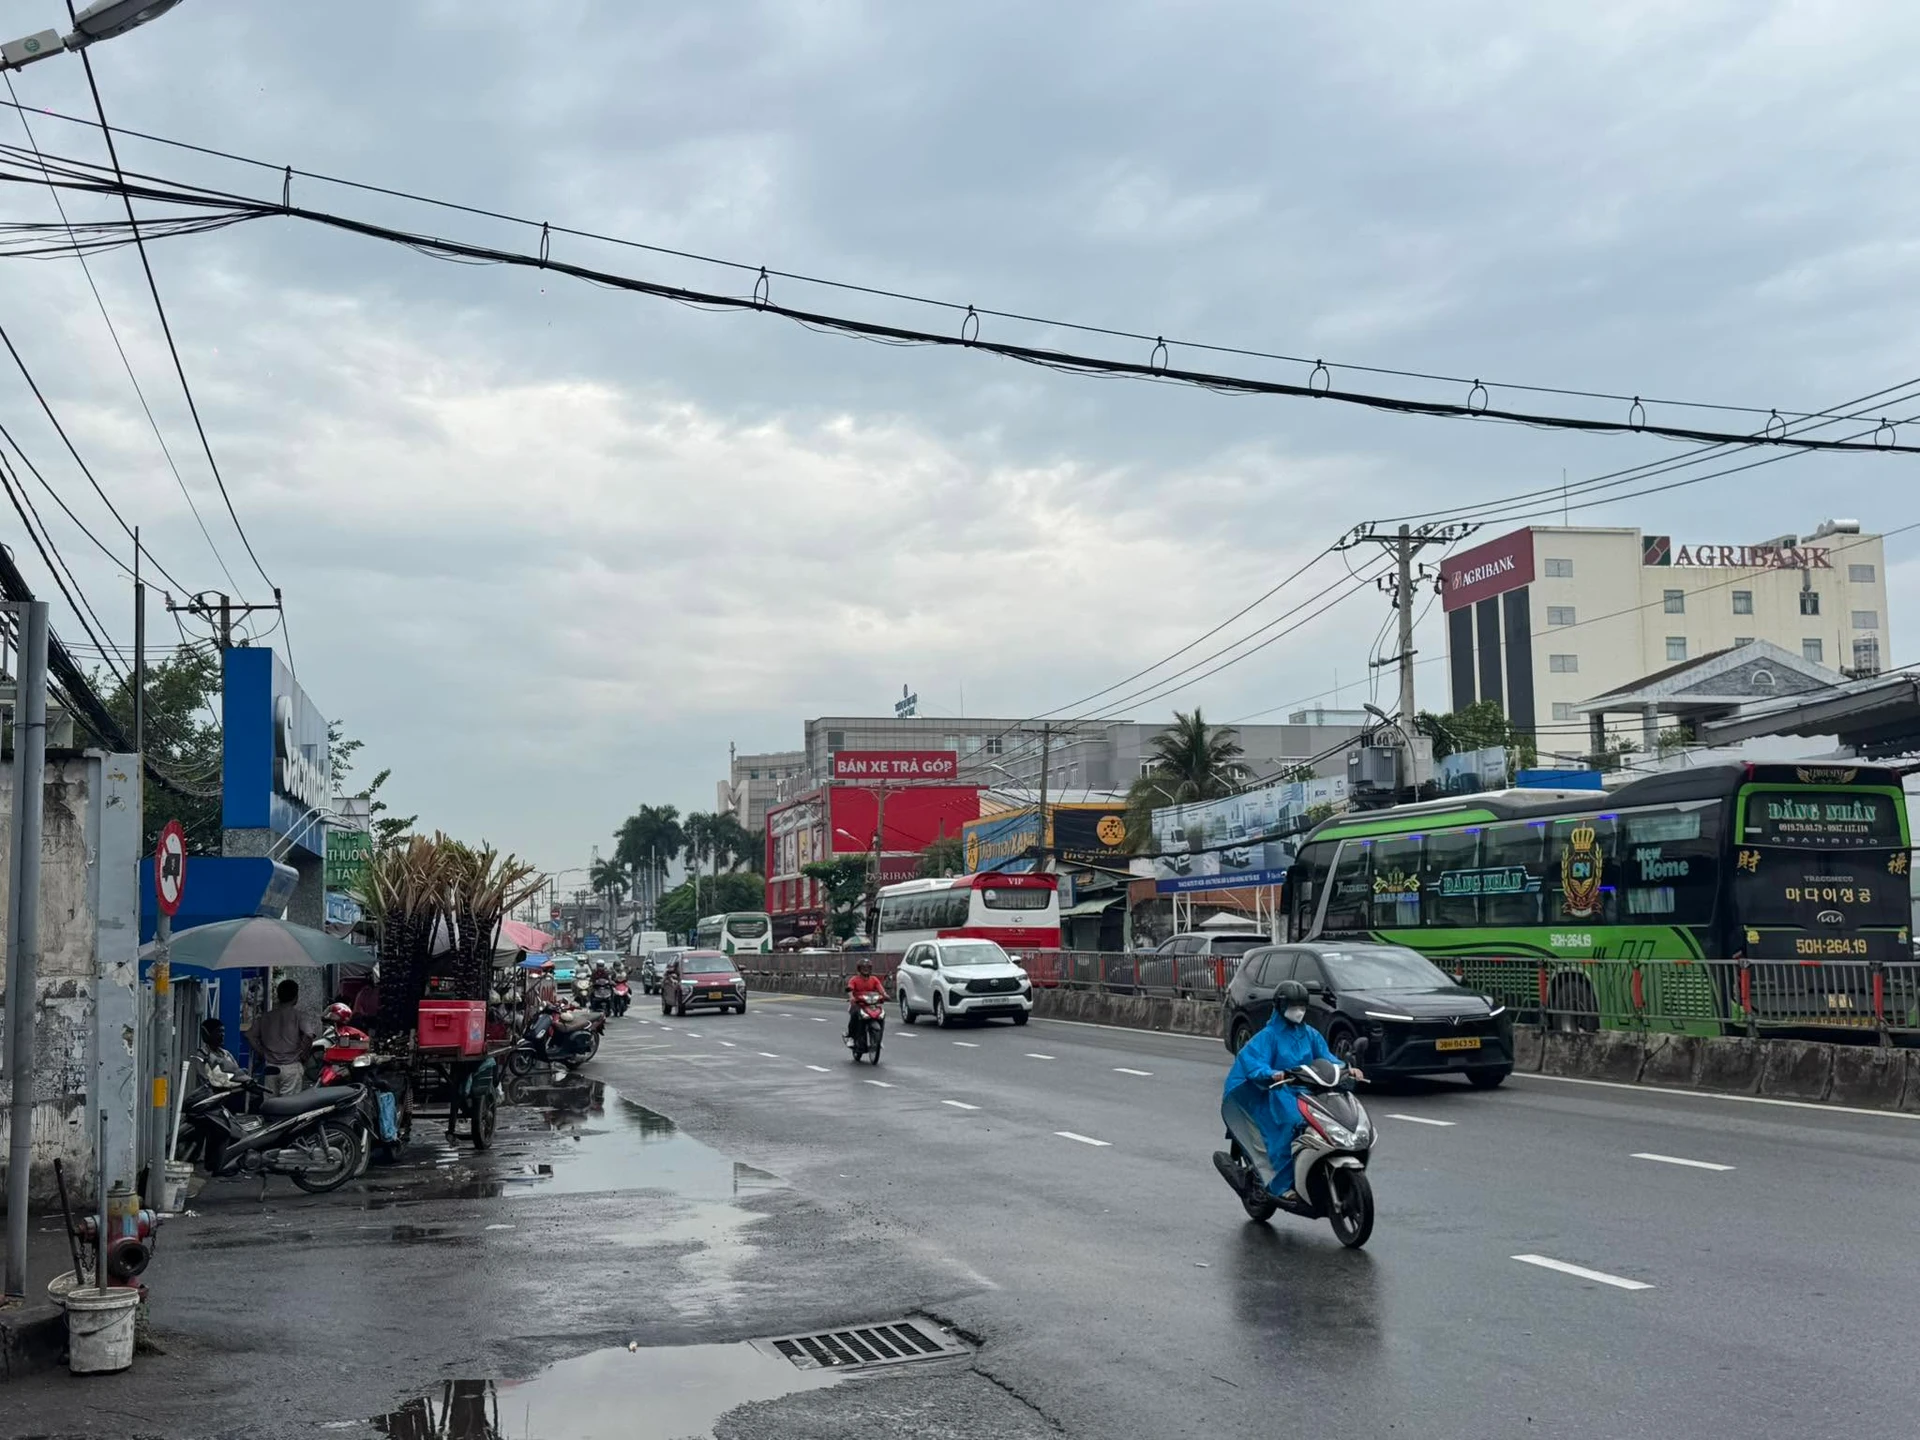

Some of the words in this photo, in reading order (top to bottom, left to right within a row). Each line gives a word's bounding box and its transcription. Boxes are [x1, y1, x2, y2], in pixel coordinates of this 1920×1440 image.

[1674, 544, 1834, 570] AGRIBANK
[1462, 554, 1515, 588] AGRIBANK
[837, 758, 867, 773] BÁN
[870, 760, 889, 773] XE
[891, 757, 920, 773] TRẢ
[922, 757, 953, 773] GÓP
[1768, 798, 1820, 820] ĐĂNG
[1825, 800, 1877, 822] NHÂN
[1635, 847, 1662, 862] New
[1640, 859, 1690, 881] Home
[1007, 877, 1024, 886] VIP
[1803, 875, 1854, 883] TRACOMECO
[1550, 934, 1592, 948] 50H-264.19
[1796, 938, 1868, 954] 50H-264.19
